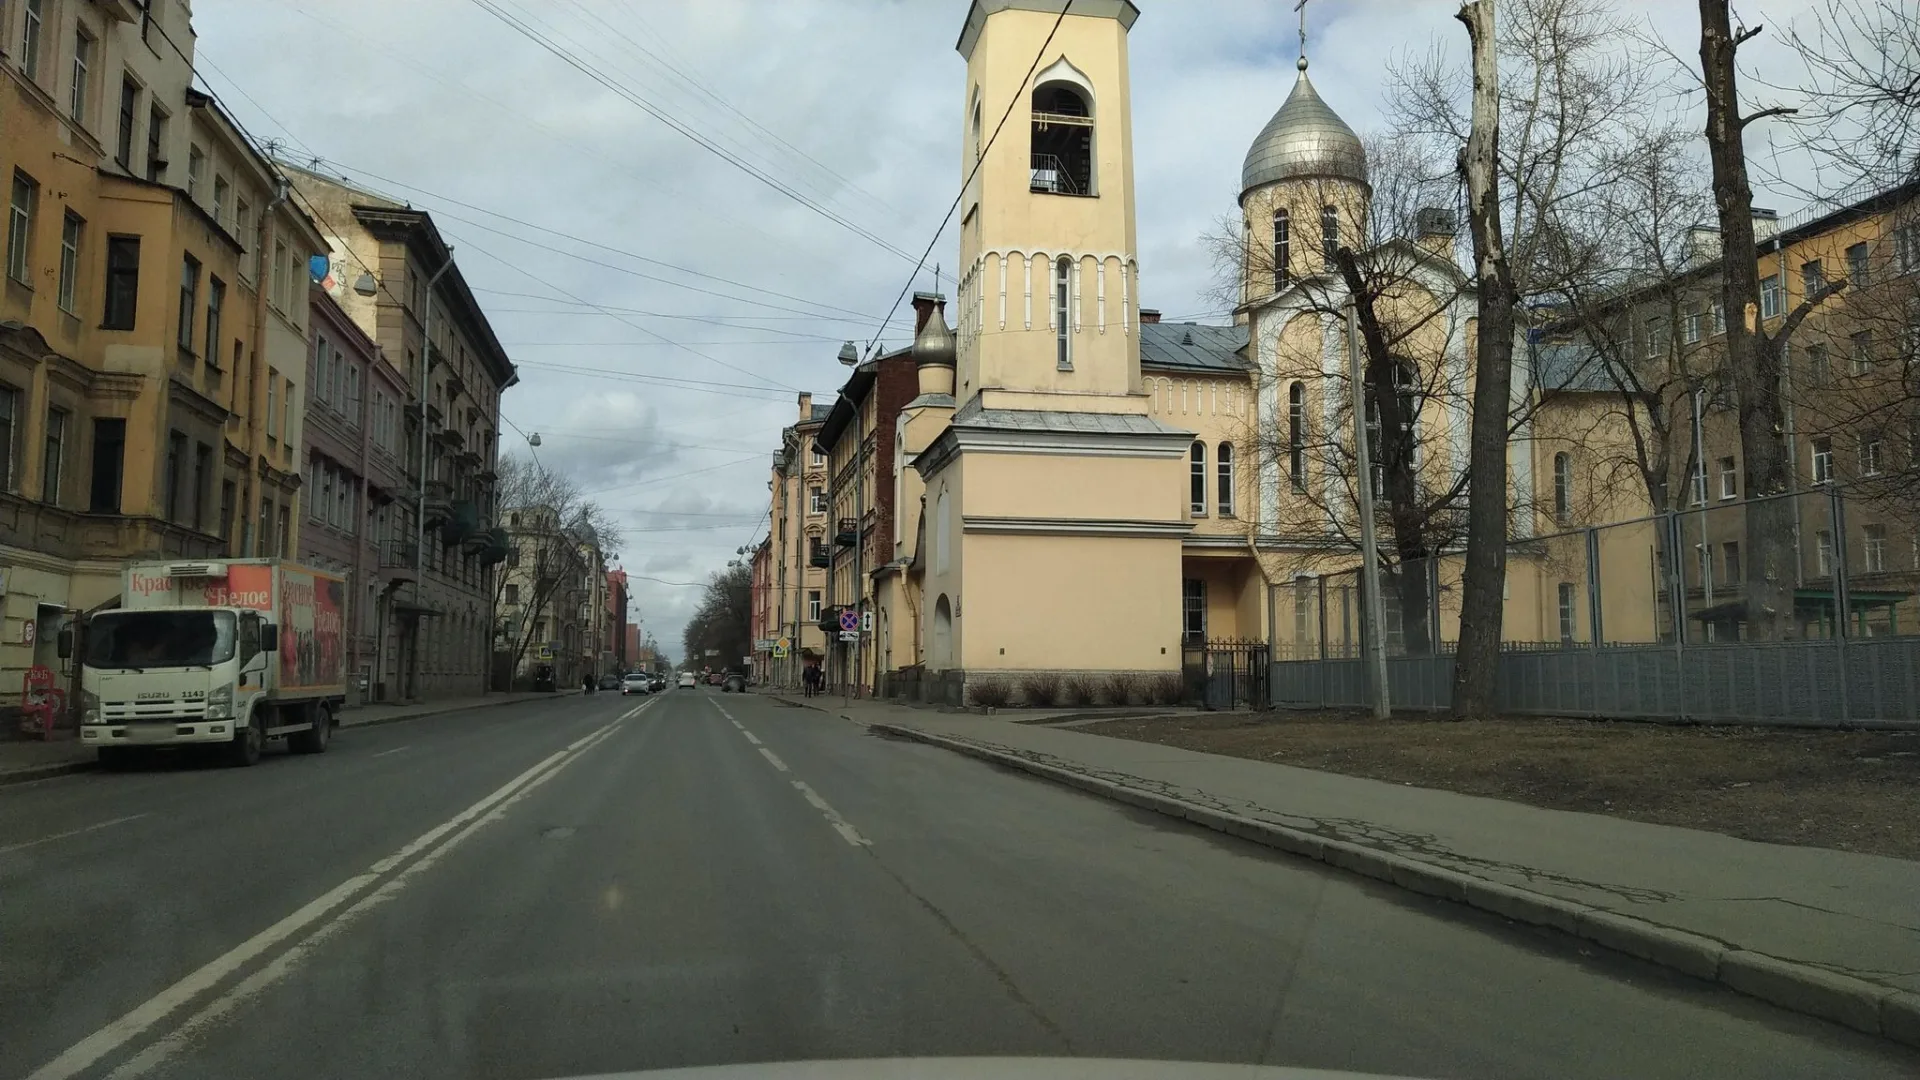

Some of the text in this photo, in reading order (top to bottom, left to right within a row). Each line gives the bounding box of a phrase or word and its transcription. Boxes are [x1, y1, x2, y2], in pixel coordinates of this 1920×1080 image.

[131, 573, 204, 596] Красое
[216, 587, 269, 606] Белое
[181, 690, 204, 698] 1143
